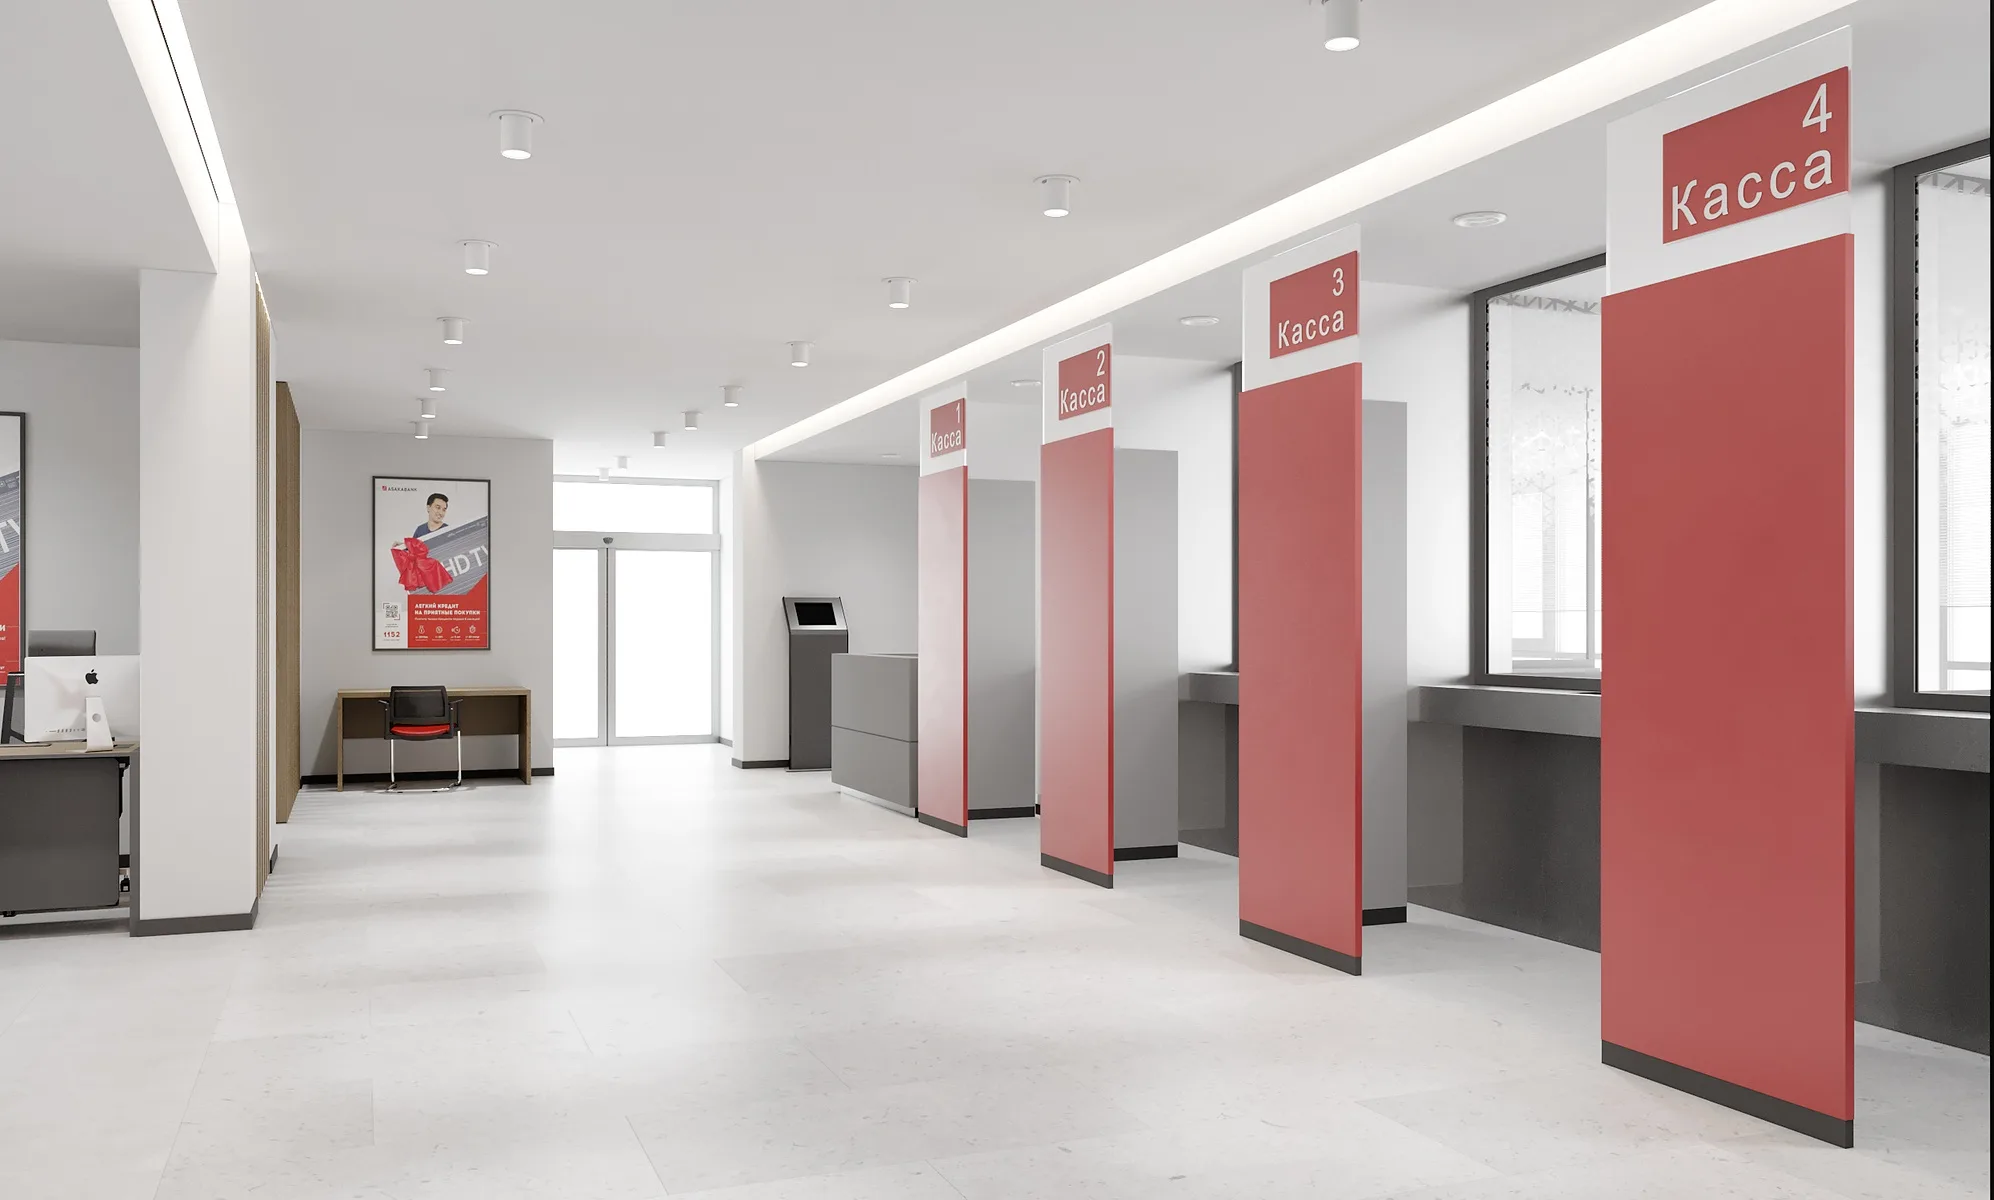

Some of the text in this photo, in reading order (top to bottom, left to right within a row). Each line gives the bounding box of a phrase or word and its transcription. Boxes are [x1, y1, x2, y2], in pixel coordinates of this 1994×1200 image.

[1802, 83, 1832, 133] 4
[1671, 149, 1832, 231] Касса
[1332, 267, 1344, 296] 3
[1278, 309, 1344, 348] Касса
[1096, 350, 1105, 376] 2
[956, 402, 960, 423] 1
[1060, 383, 1105, 414] Касса
[931, 429, 961, 453] Касса
